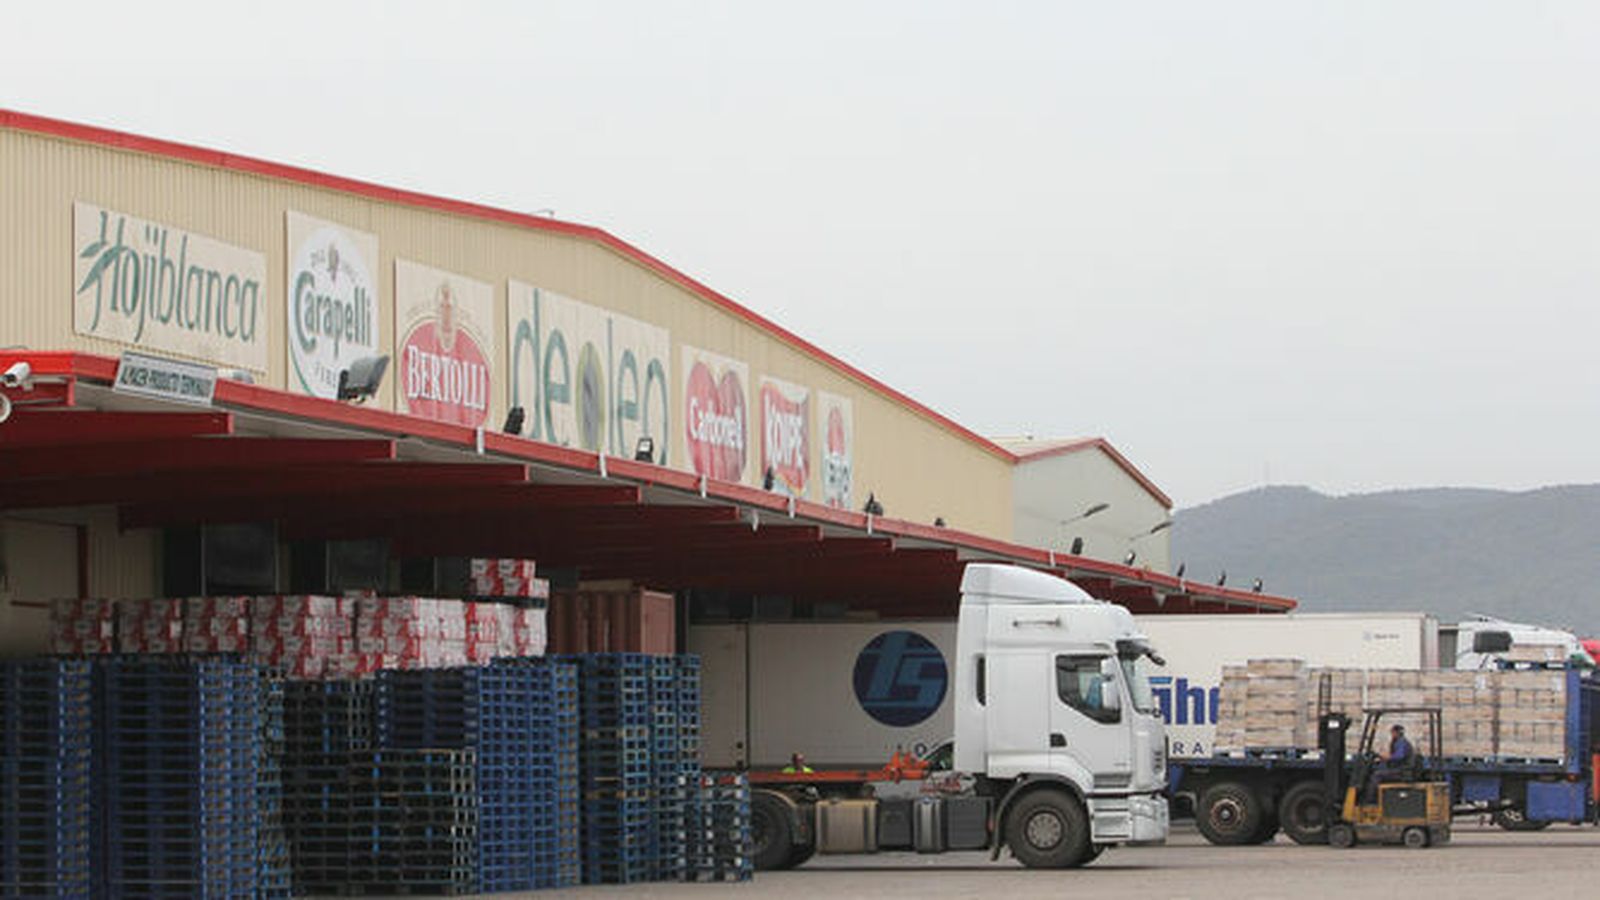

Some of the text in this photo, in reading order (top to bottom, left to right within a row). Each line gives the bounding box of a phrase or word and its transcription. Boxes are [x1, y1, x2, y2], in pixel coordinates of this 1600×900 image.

[78, 211, 259, 342] Hojiblanca
[295, 271, 372, 358] Carapelli
[407, 344, 486, 412] BERTOLLI
[690, 397, 744, 451] Carbonell
